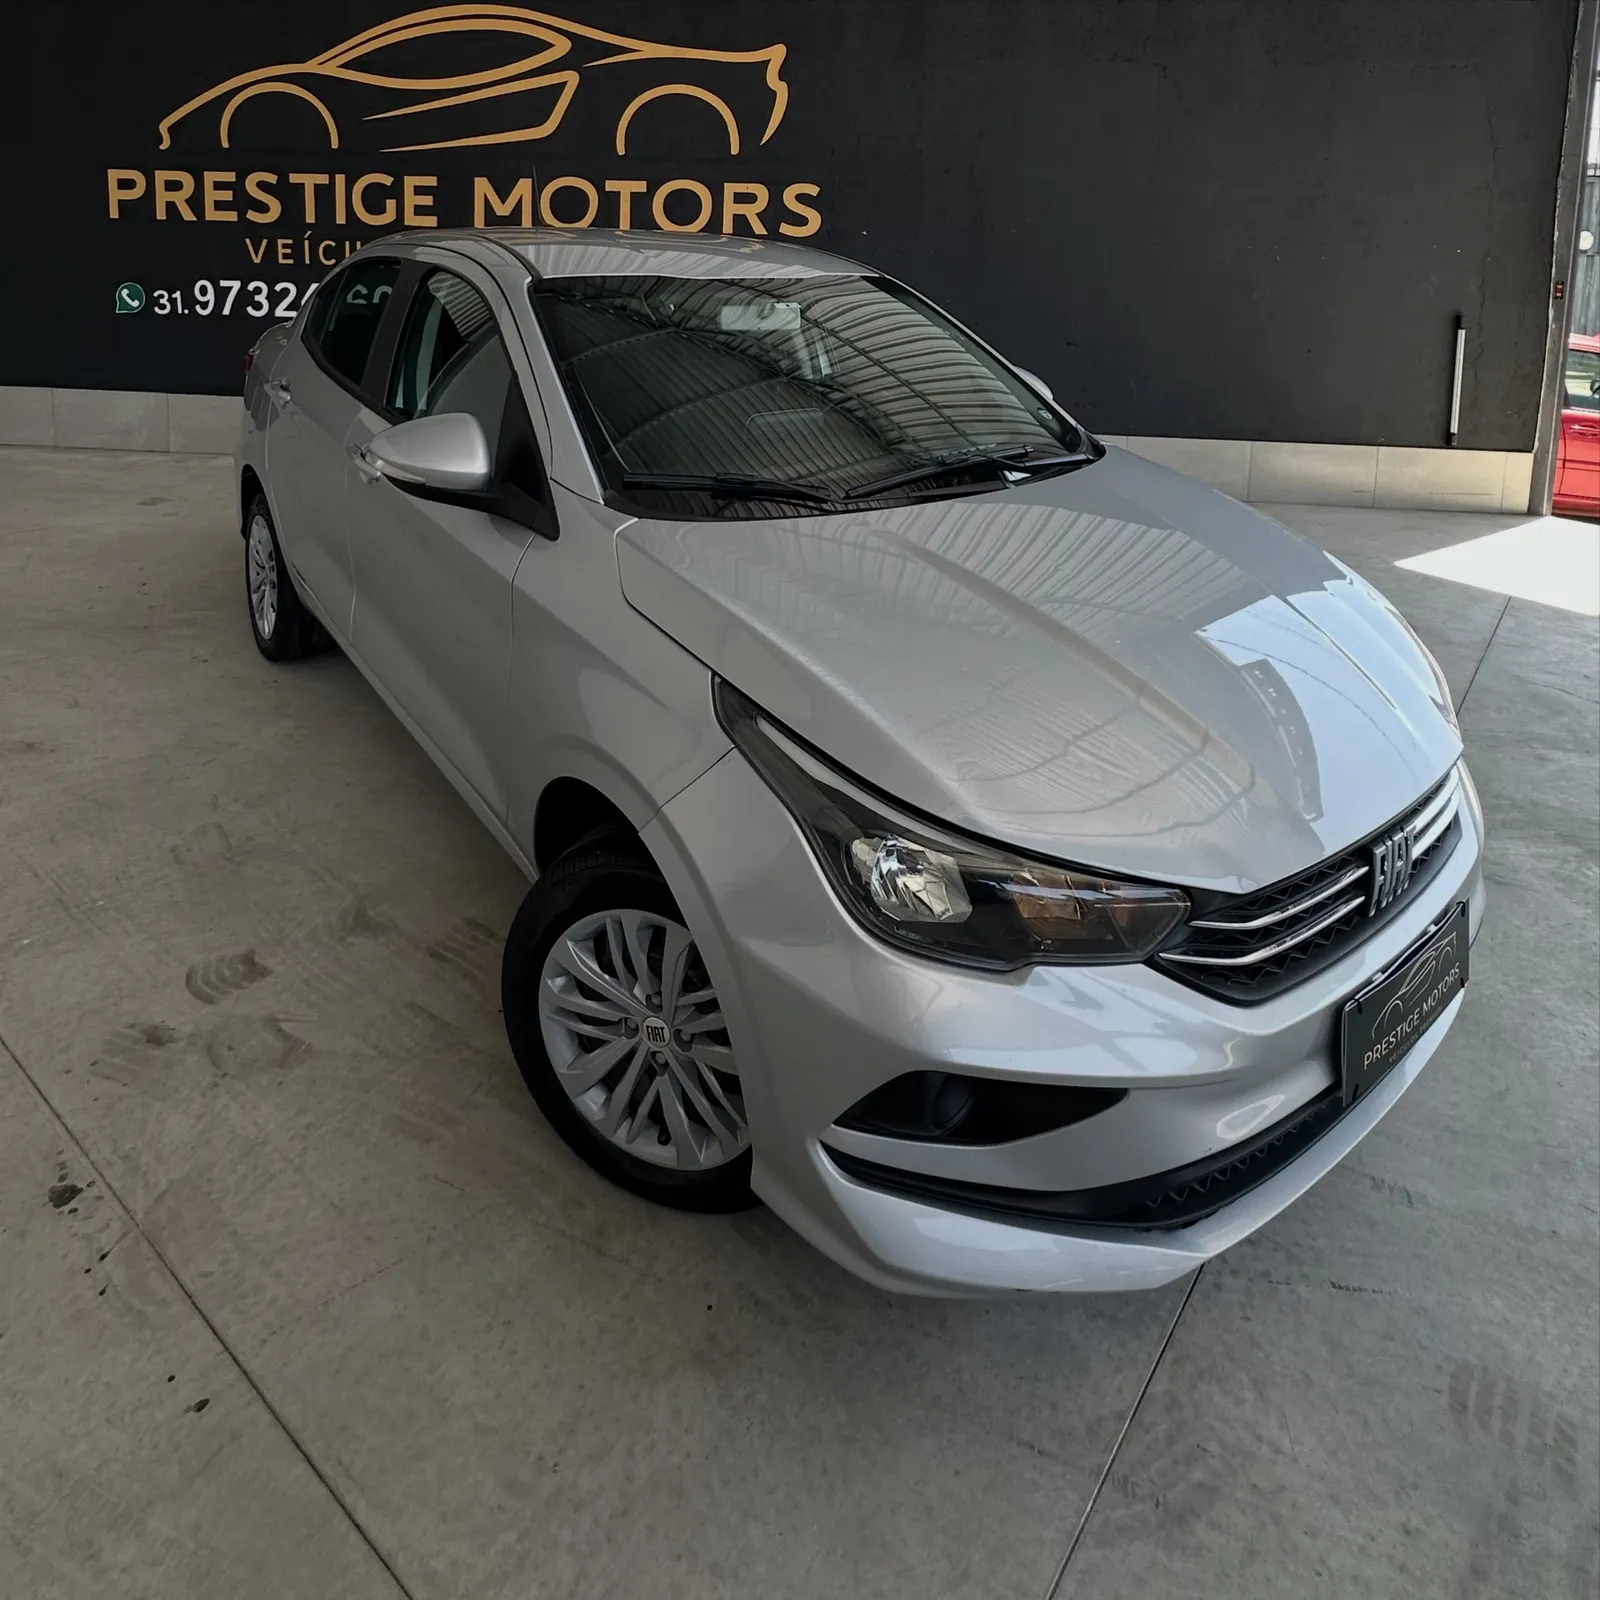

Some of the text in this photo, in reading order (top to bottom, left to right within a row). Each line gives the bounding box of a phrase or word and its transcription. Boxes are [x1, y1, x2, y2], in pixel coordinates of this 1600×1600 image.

[107, 168, 822, 238] PRESTIGE MOTORS
[1369, 825, 1417, 917] FIAT
[646, 1025, 666, 1043] FIAT
[1363, 961, 1460, 1070] PRESTIGE MOTORS
